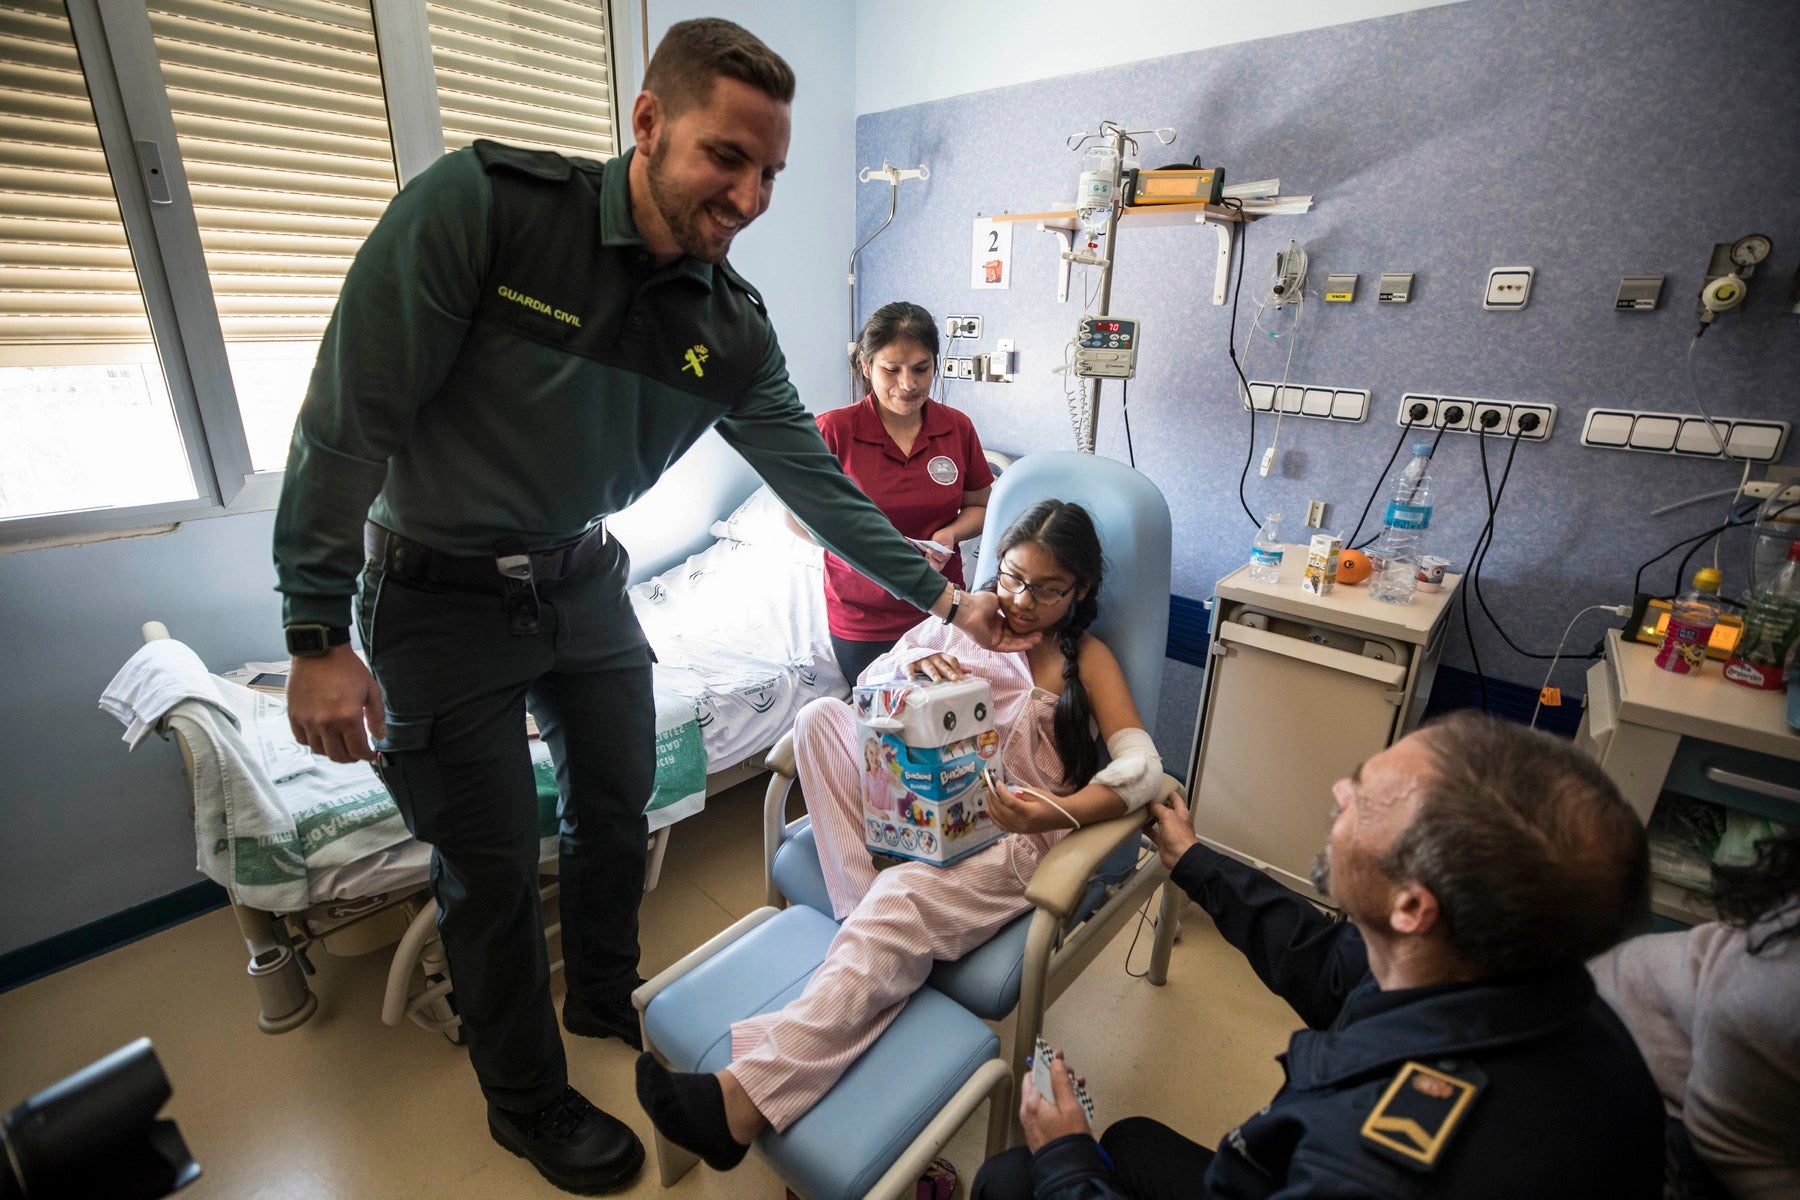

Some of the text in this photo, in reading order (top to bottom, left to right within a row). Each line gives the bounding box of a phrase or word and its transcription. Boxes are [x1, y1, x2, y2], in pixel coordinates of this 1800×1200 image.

[988, 230, 999, 252] 2
[497, 285, 582, 328] GUARDIA CIVIL
[1109, 323, 1120, 331] 70
